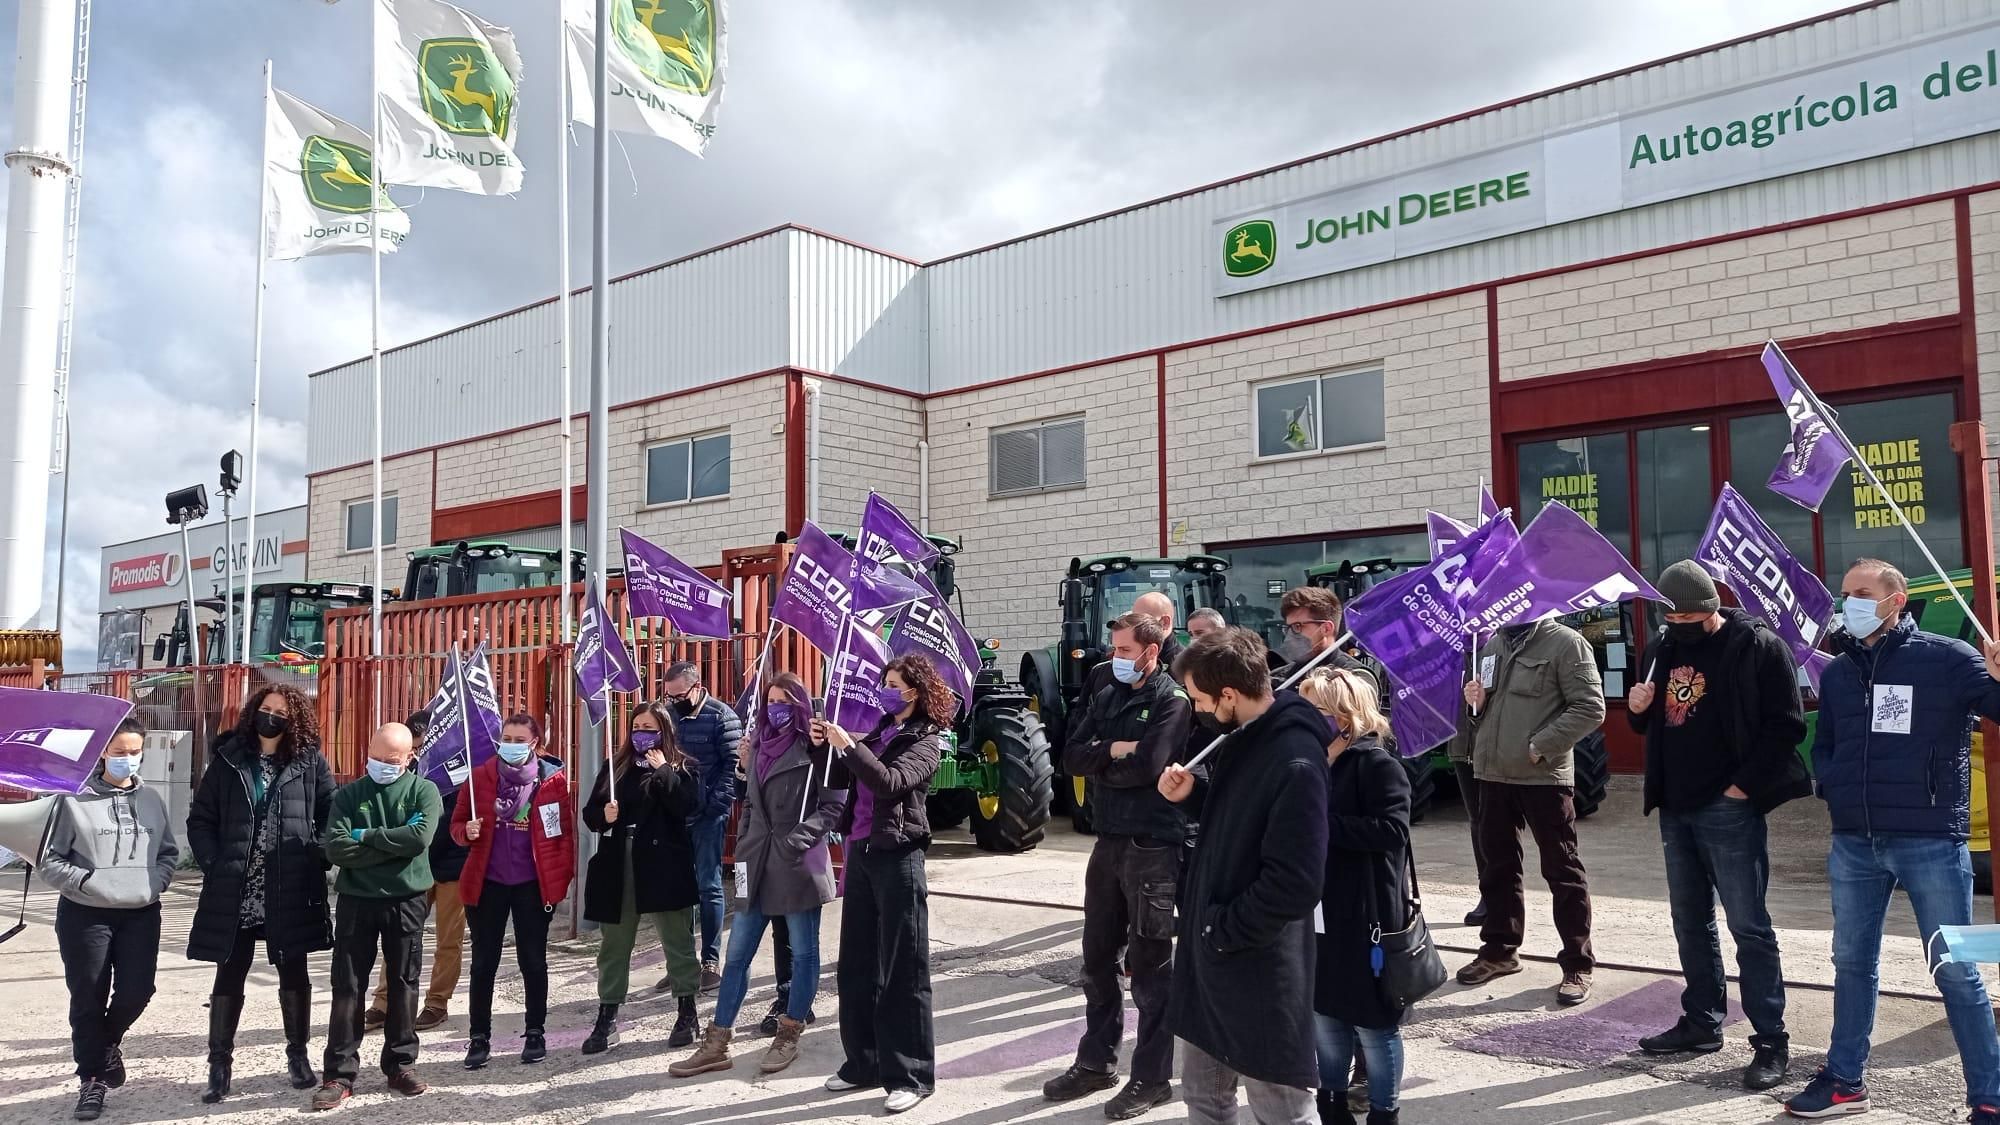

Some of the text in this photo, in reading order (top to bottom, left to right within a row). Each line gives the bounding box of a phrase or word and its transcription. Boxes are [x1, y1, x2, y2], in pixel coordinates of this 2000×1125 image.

[1629, 50, 1998, 169] Autoagrícola del
[1296, 170, 1530, 249] JOHN DEERE
[304, 223, 351, 238] JOHN
[1542, 473, 1598, 497] NADIE
[1886, 468, 1895, 480] A
[1897, 465, 1922, 480] DAR
[1578, 497, 1598, 509] DAR
[111, 559, 161, 586] Promodis
[1717, 517, 1796, 613] CCOO
